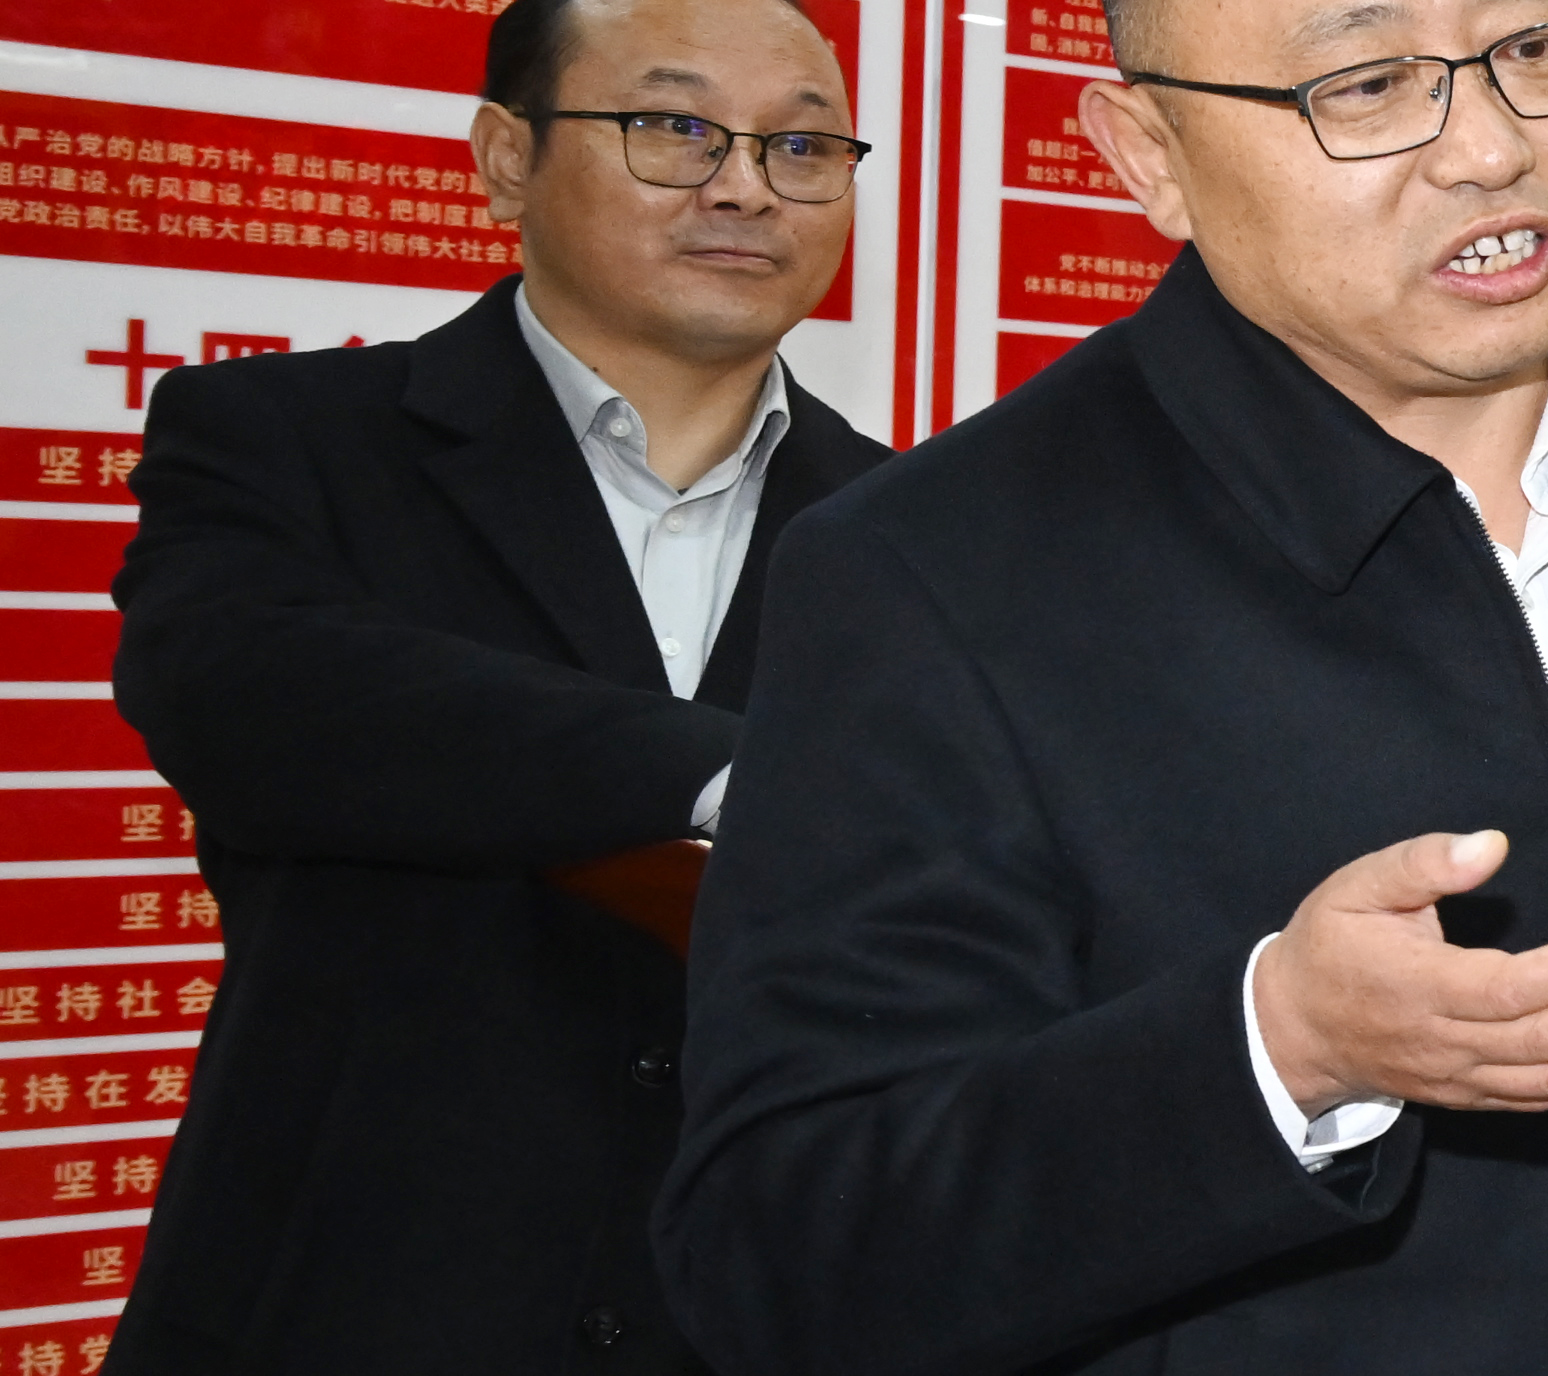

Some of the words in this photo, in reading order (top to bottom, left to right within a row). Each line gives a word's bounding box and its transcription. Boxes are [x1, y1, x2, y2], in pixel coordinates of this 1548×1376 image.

[119, 889, 220, 931] 坚持
[0, 1065, 190, 1115] 持在发
[52, 1154, 158, 1201] 坚持
